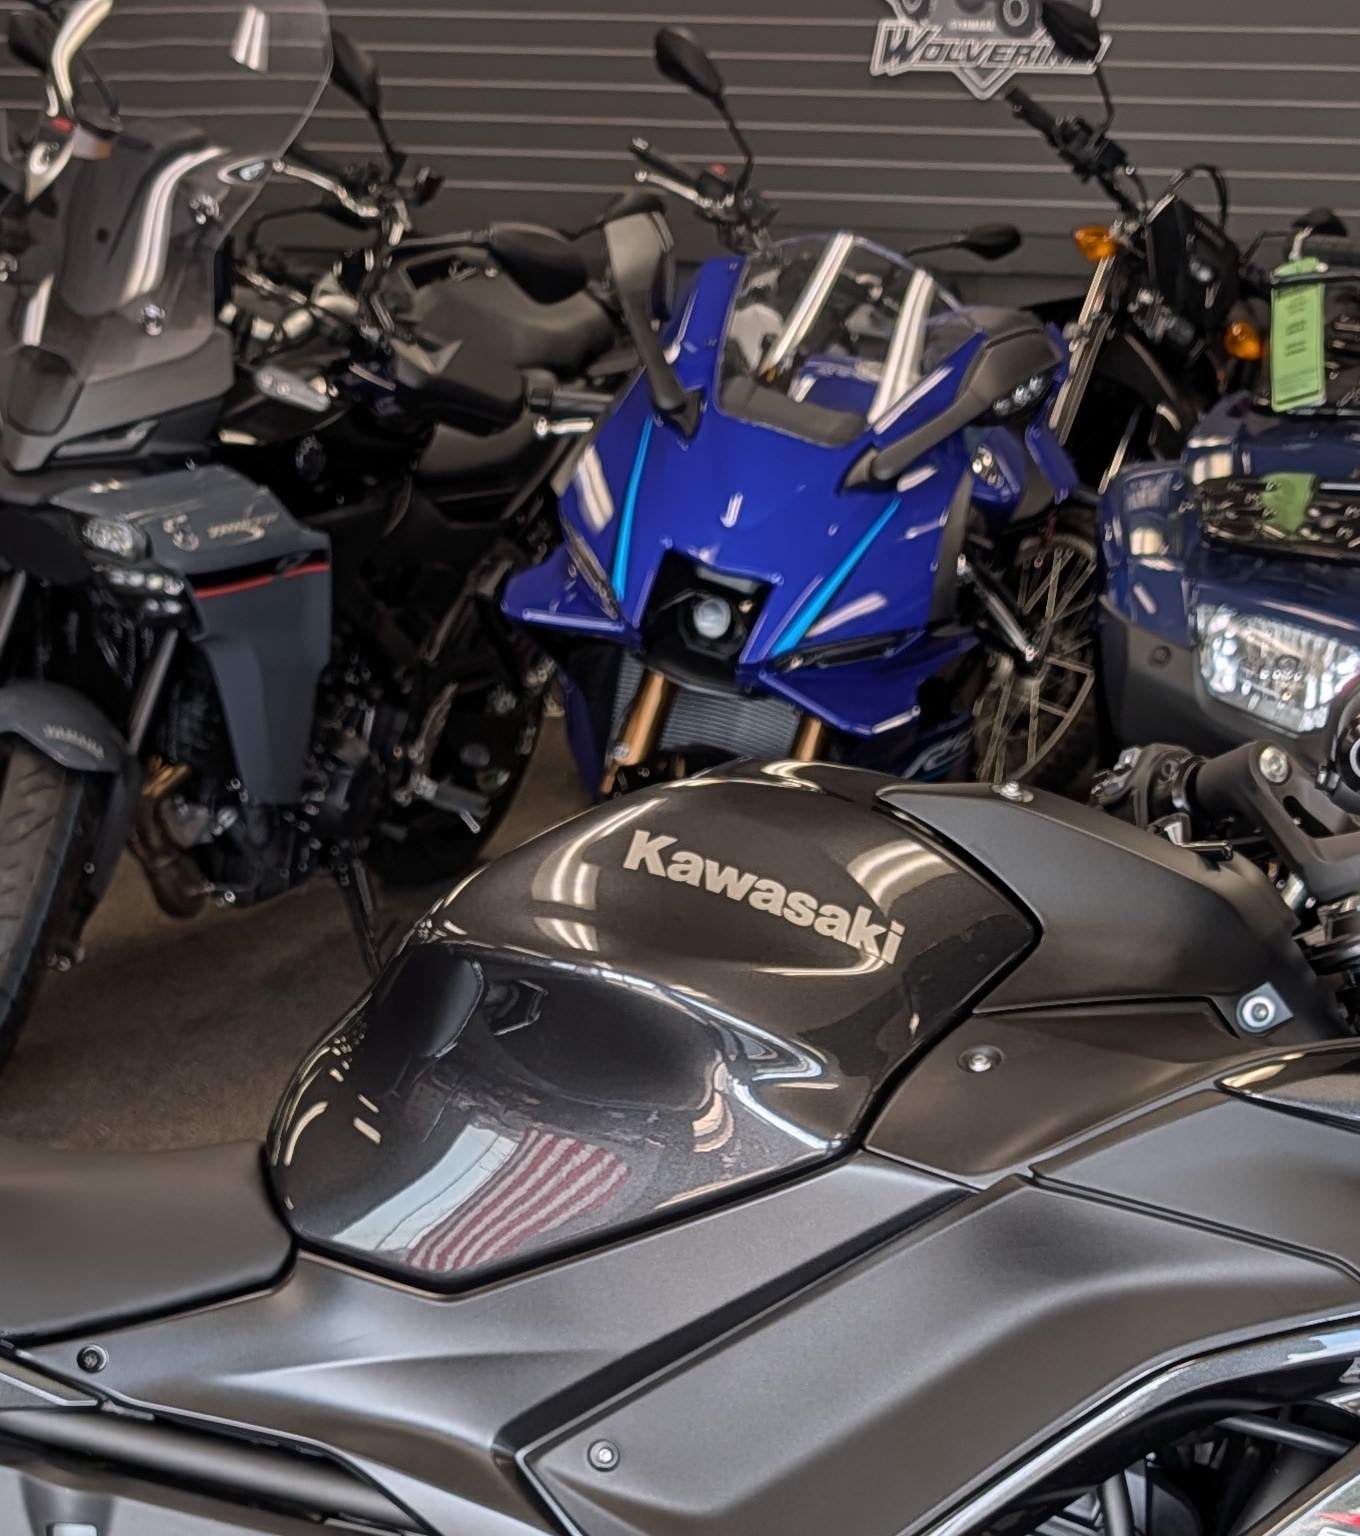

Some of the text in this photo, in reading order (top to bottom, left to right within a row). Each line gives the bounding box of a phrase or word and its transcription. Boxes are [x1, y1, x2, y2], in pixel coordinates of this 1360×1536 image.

[880, 26, 1098, 69] WOLVERI
[42, 723, 104, 760] YAMAHA
[623, 829, 906, 965] Kawasaki
